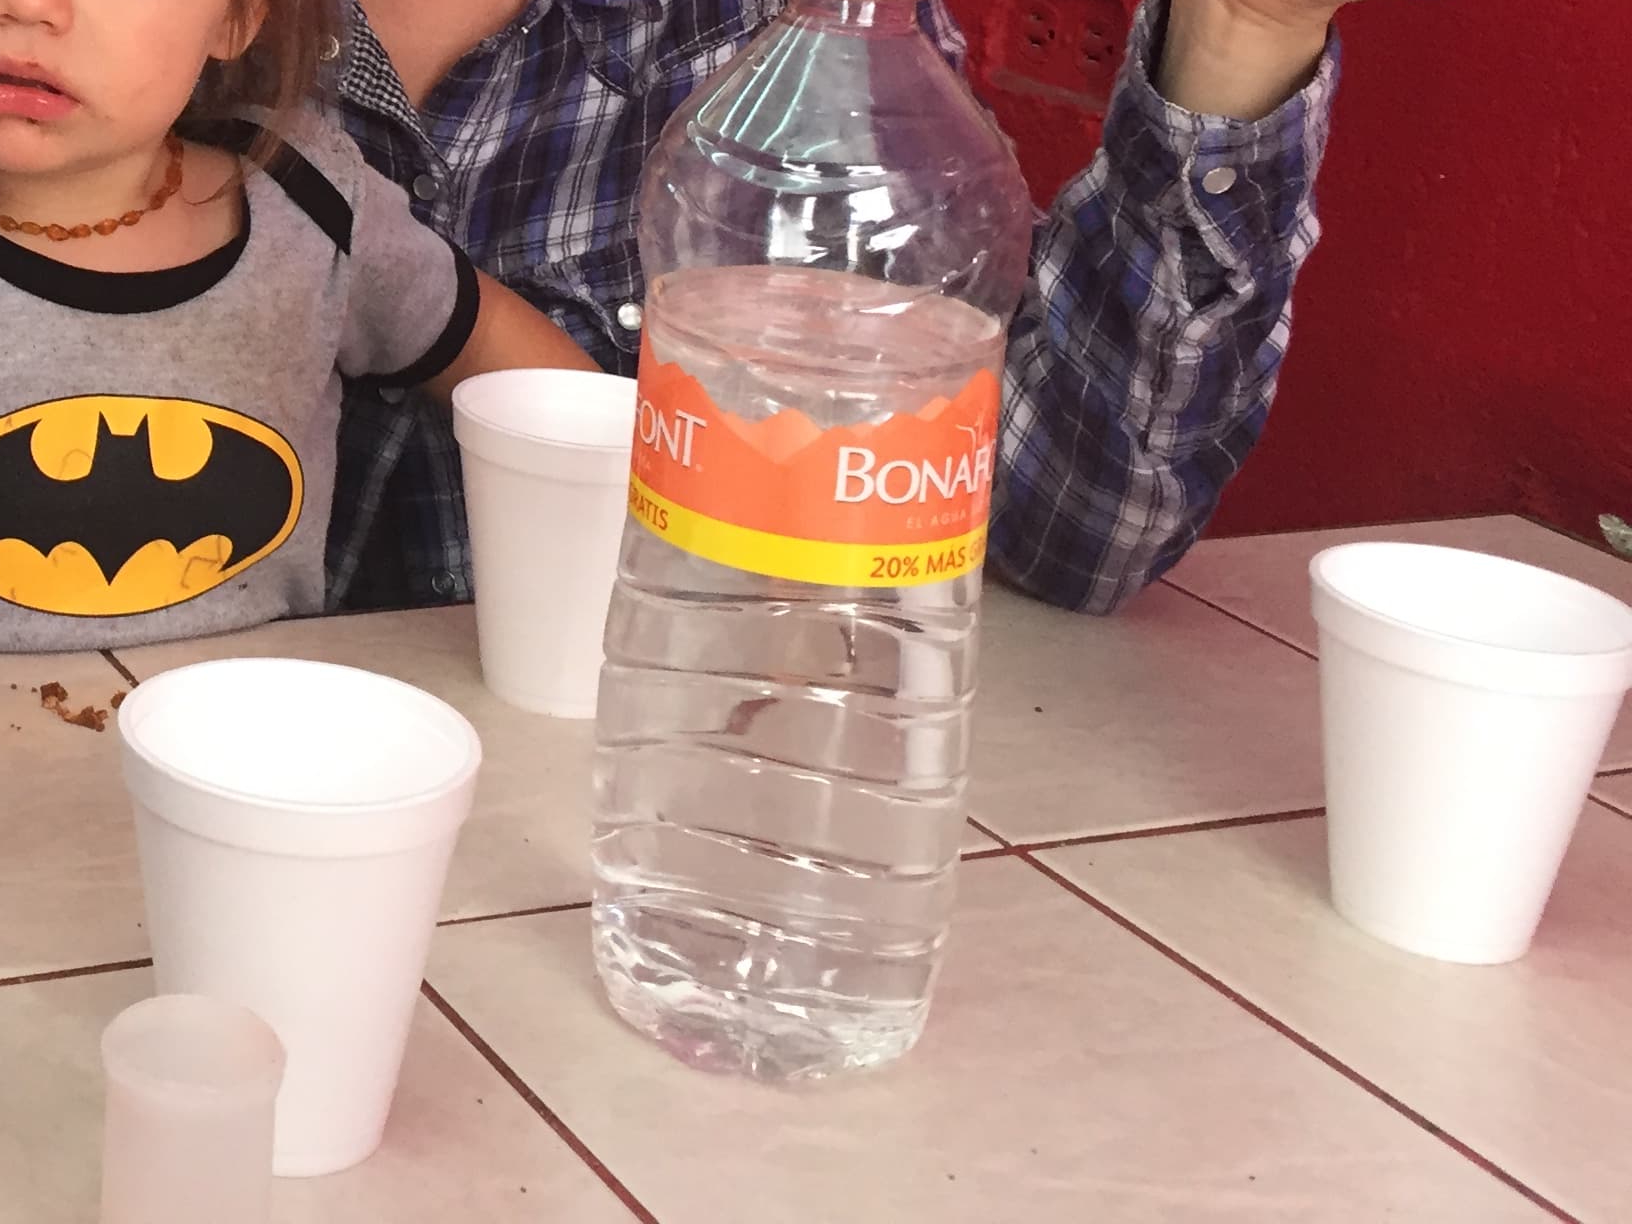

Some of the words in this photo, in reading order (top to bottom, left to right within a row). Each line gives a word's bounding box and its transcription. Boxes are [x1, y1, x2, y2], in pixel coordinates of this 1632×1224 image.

[636, 393, 708, 468] ONT
[629, 483, 669, 530] RATIS
[930, 508, 966, 527] AGUA
[870, 556, 919, 578] 20%
[926, 545, 966, 575] MÁS
